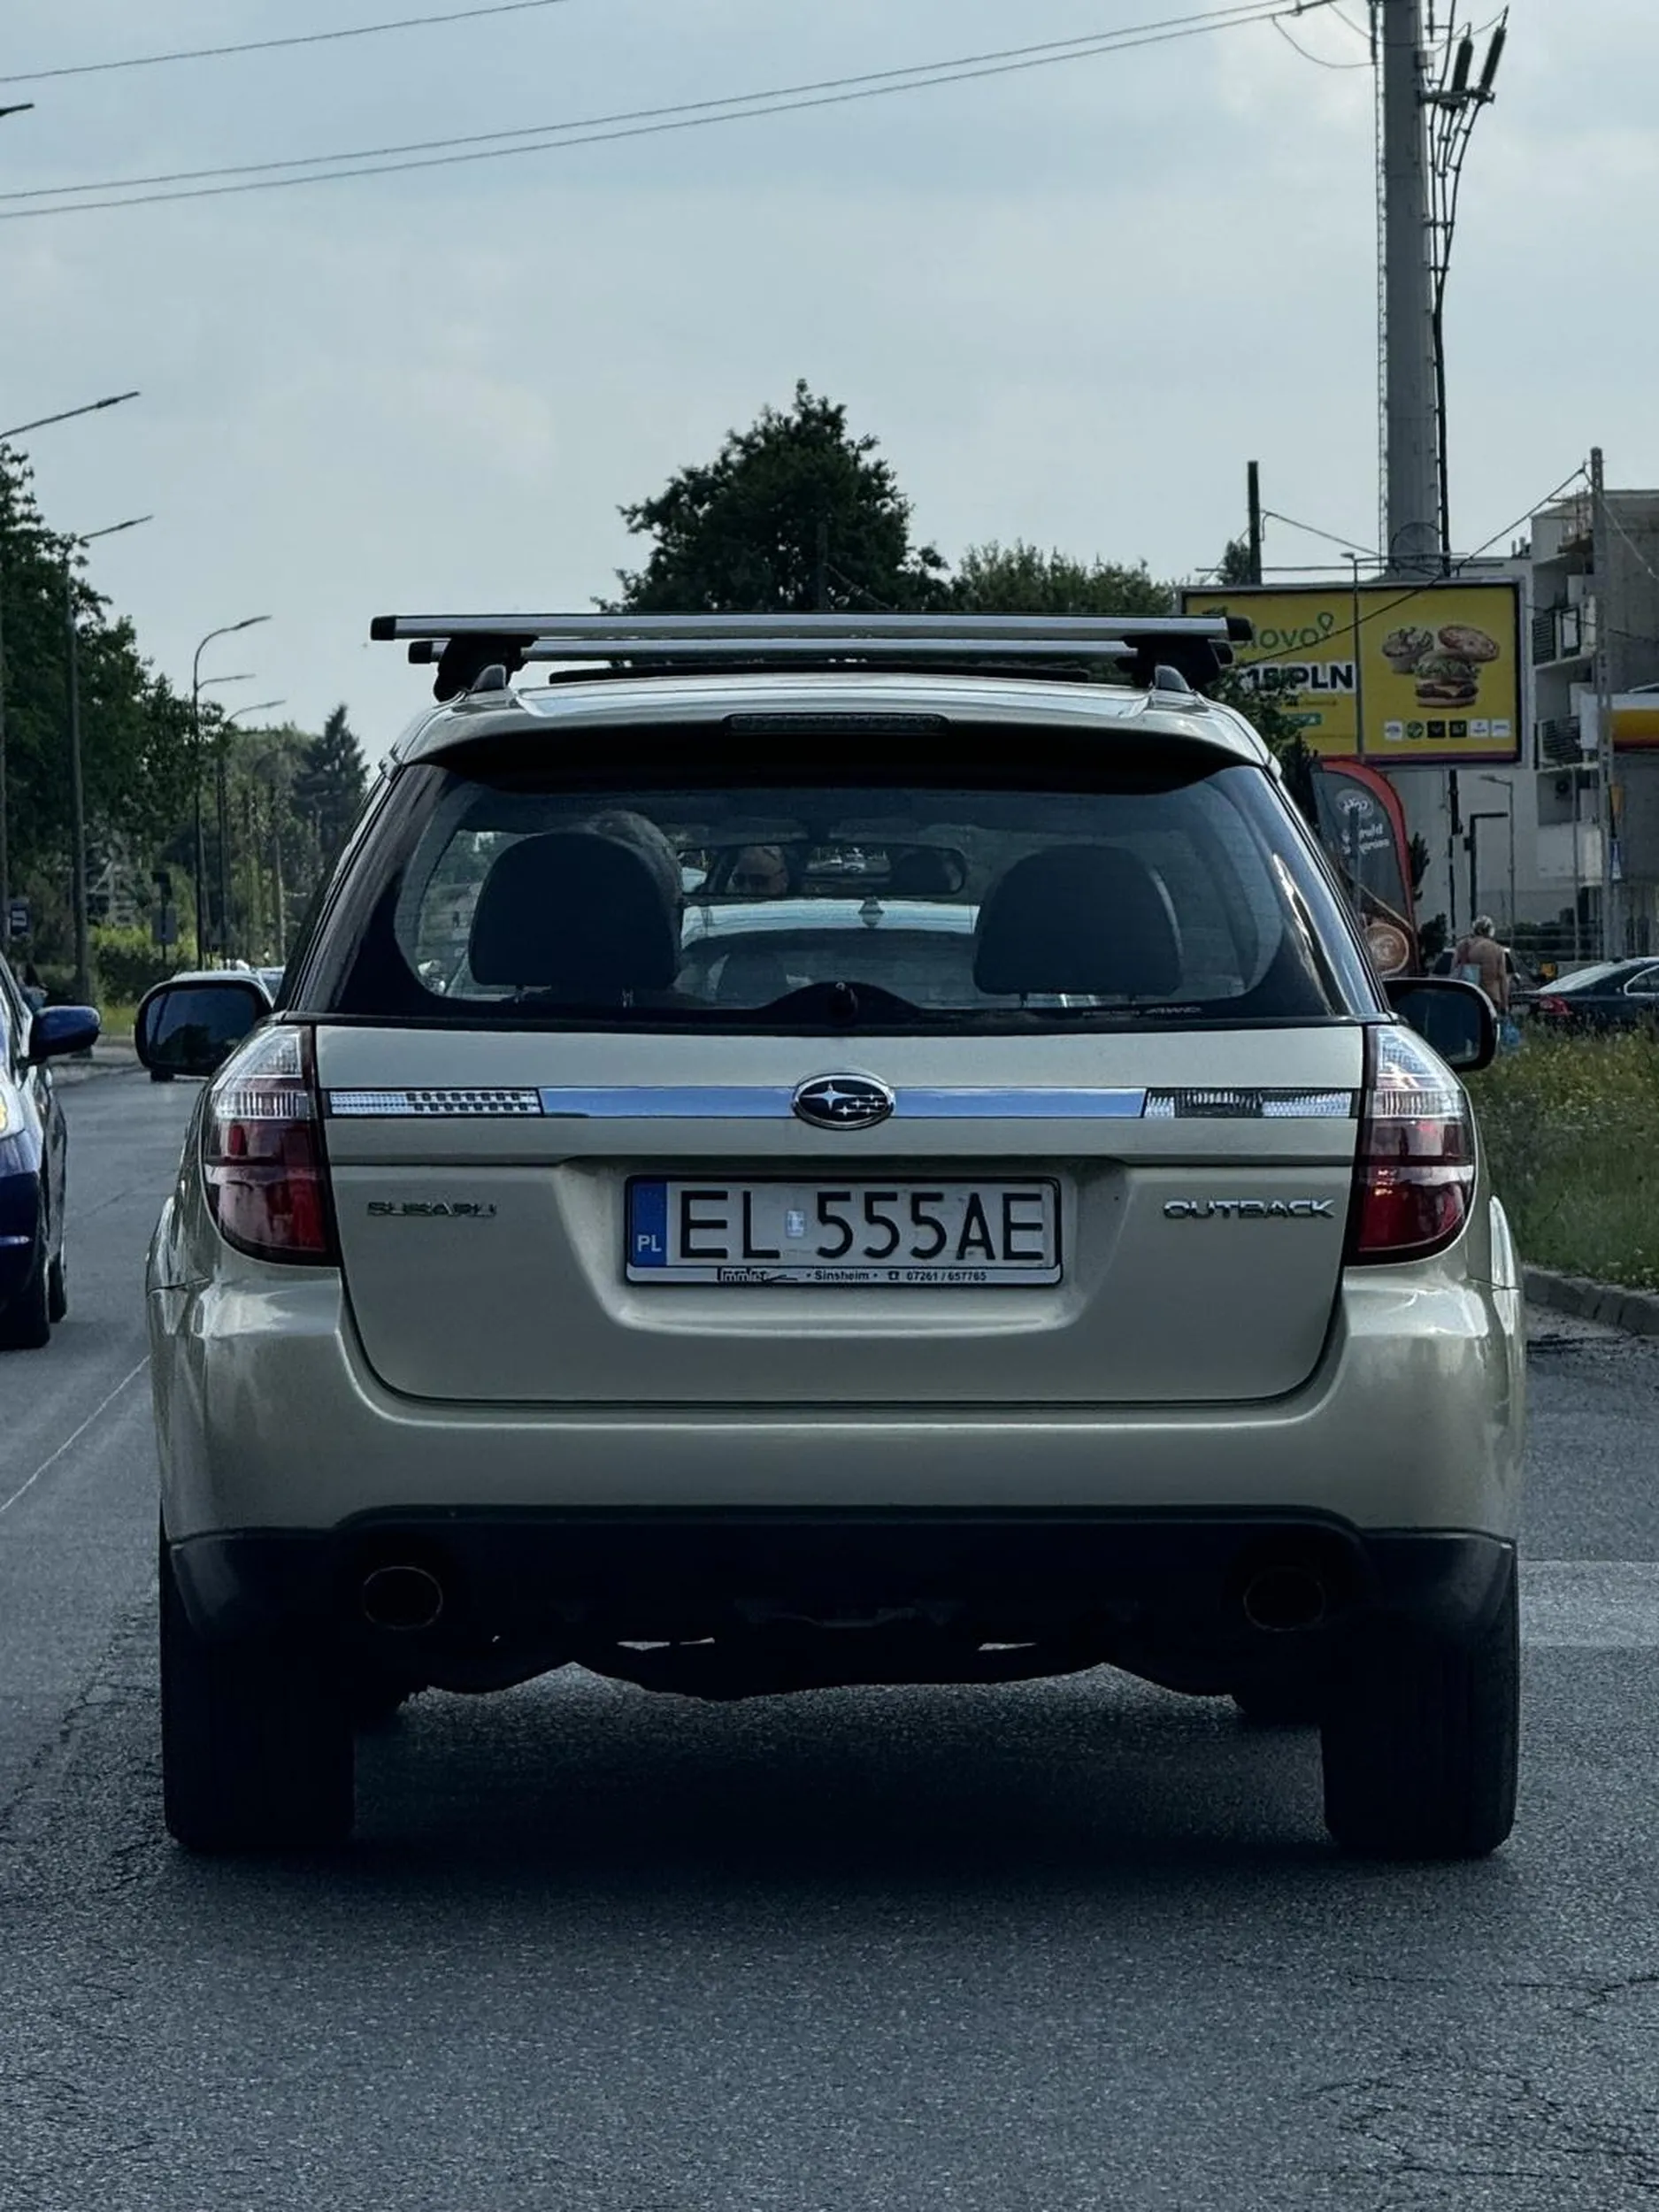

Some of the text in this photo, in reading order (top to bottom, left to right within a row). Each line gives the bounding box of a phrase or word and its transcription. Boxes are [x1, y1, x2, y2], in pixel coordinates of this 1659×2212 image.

[1289, 664, 1353, 690] PLN
[1163, 1199, 1334, 1219] OUTBACK
[680, 1190, 1044, 1260] EL 555AE
[637, 1234, 662, 1252] PL
[814, 1270, 870, 1280] Sinsheim
